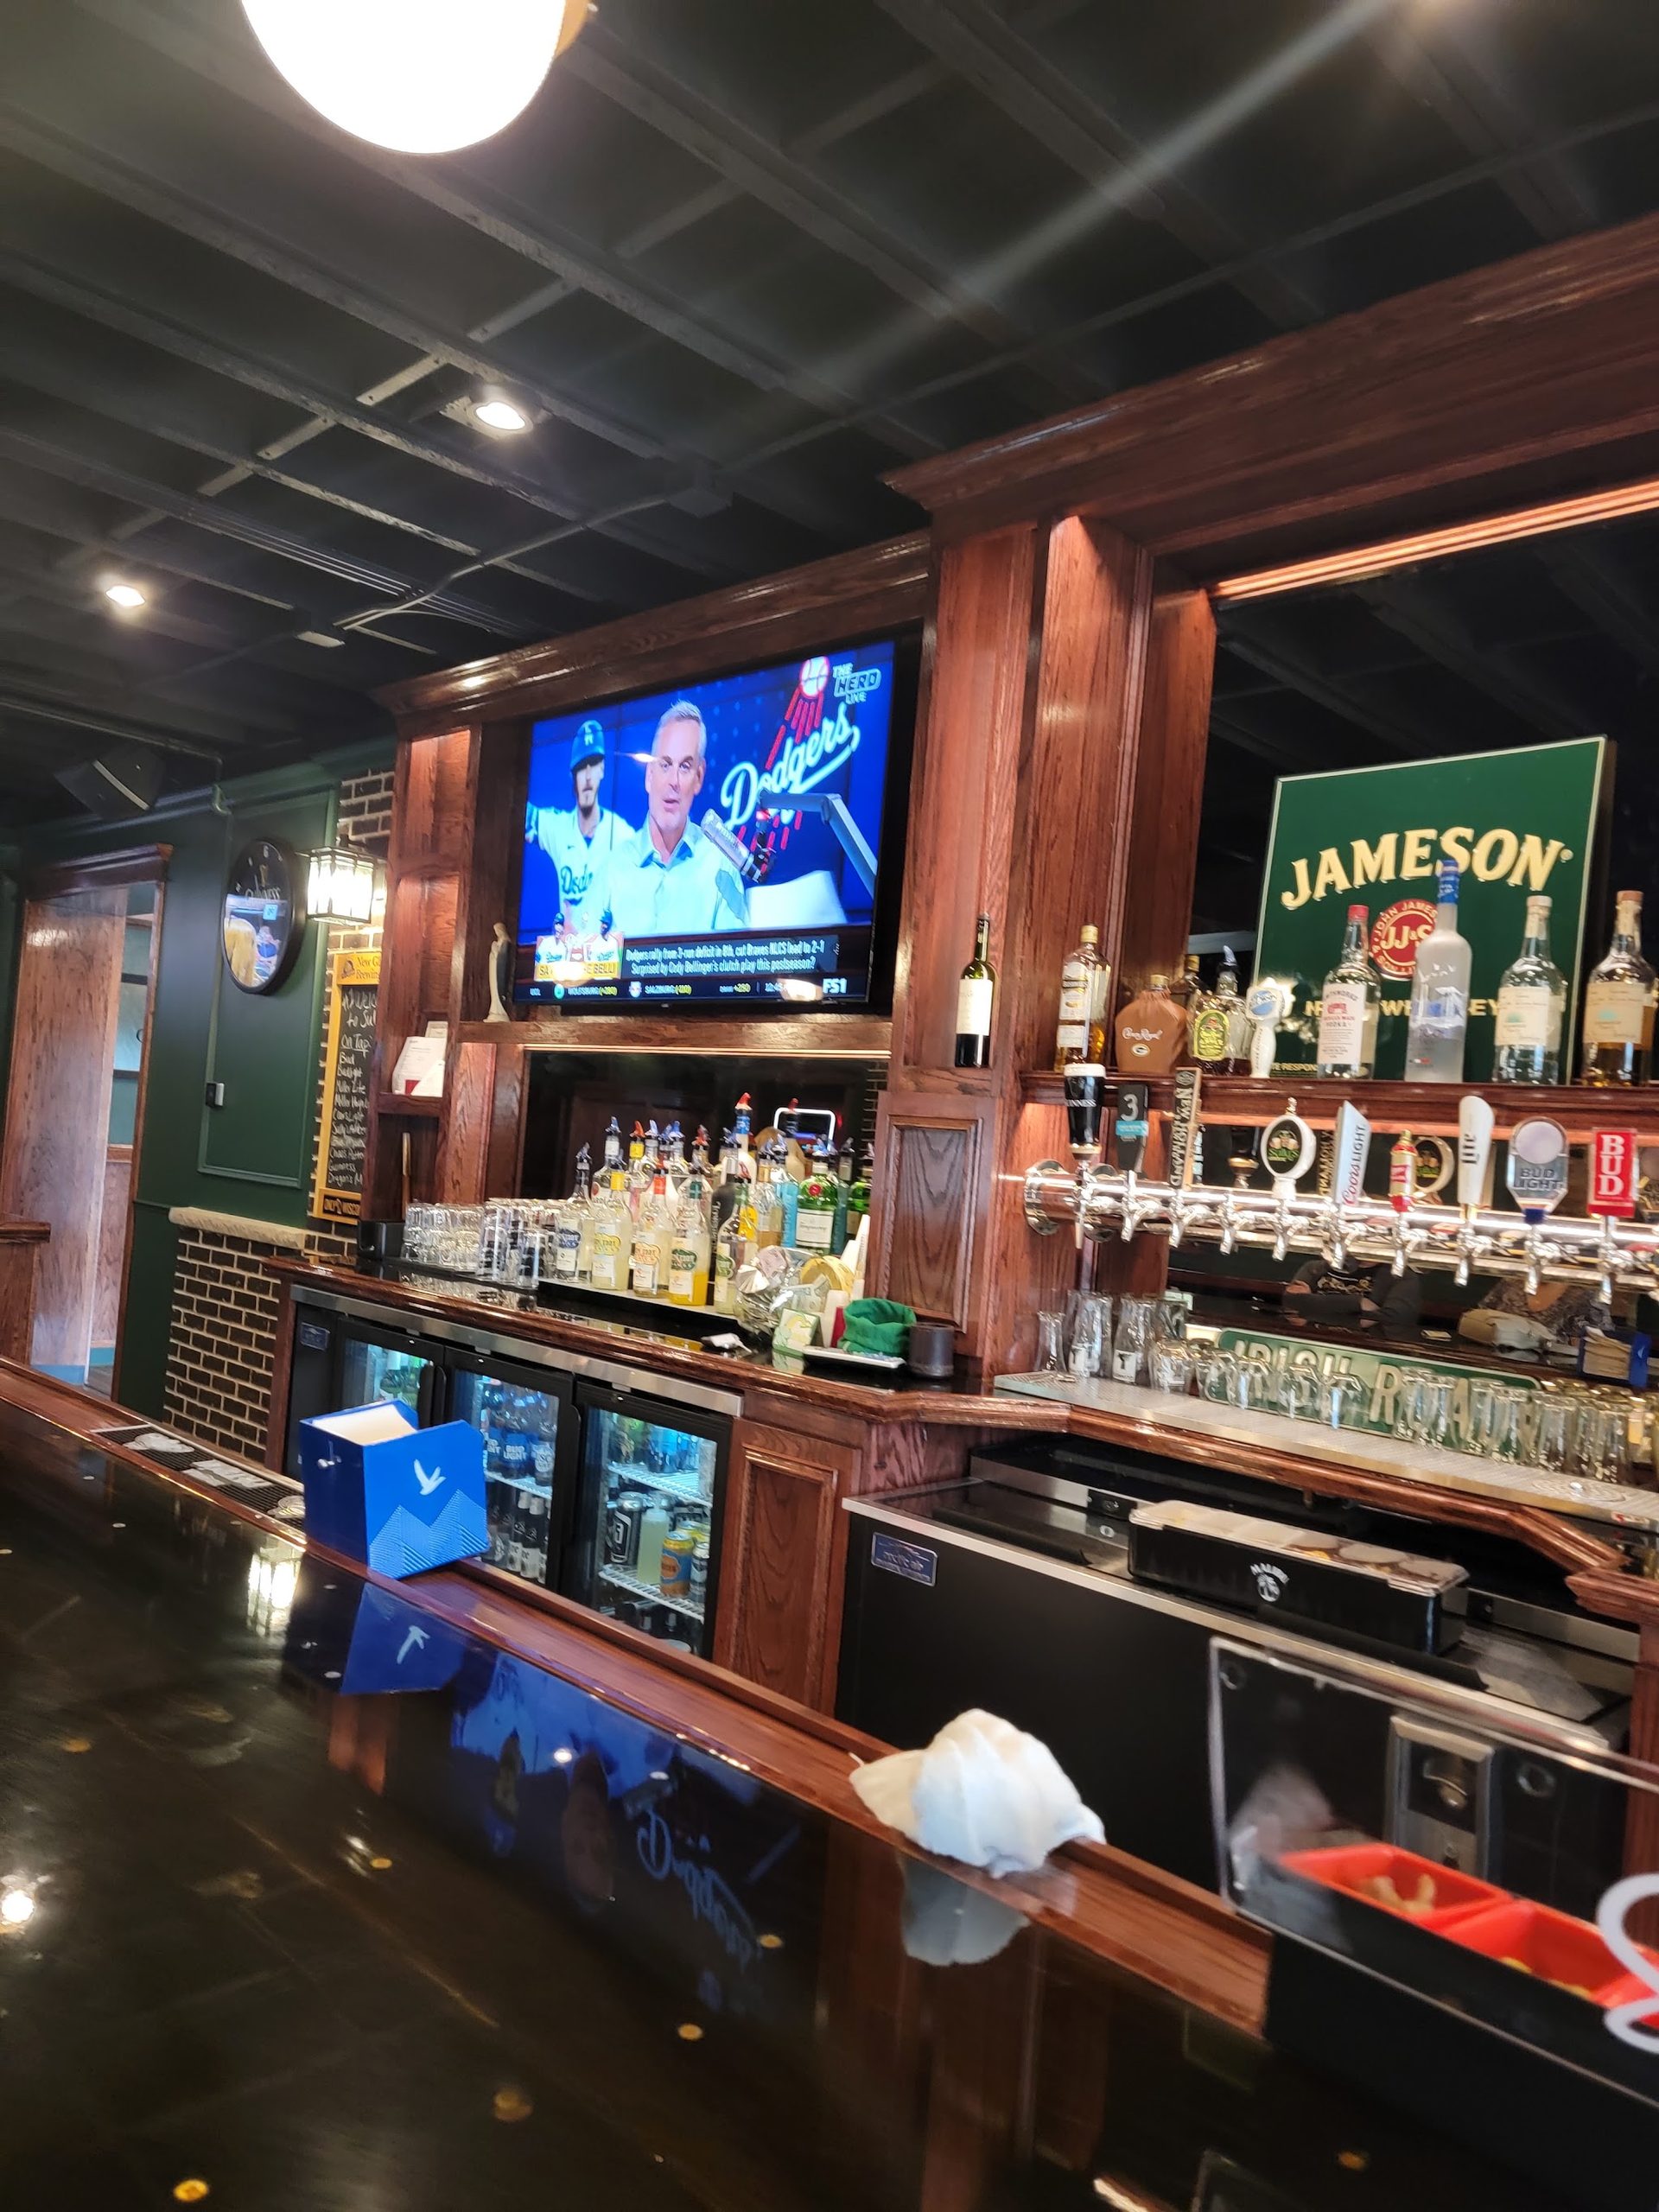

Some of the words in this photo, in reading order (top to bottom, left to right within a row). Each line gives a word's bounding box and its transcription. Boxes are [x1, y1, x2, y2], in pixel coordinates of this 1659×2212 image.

[833, 663, 854, 678] THE
[836, 670, 881, 695] HERD
[721, 702, 861, 831] Dodgers
[1281, 827, 1567, 911] JAMESON
[1374, 907, 1398, 938] JOHN
[1402, 901, 1438, 918] JAMES
[663, 947, 677, 959] from
[677, 946, 695, 959] 3-run
[695, 944, 715, 958] deficit
[715, 944, 722, 957] in
[747, 943, 769, 957] Braves
[769, 941, 787, 955] NLCS
[787, 940, 804, 955] lead
[804, 941, 811, 954] to
[811, 938, 825, 954] 2-1
[719, 958, 741, 972] clutch
[741, 958, 756, 974] play
[756, 957, 771, 970] this
[771, 955, 817, 973] postseason?
[823, 977, 848, 994] FS1
[1121, 1094, 1138, 1122] 3
[1342, 1167, 1360, 1207] Coors
[1355, 1124, 1366, 1165] LIGHT
[1520, 1167, 1555, 1180] BUD
[1599, 1134, 1626, 1196] BUD
[1514, 1179, 1565, 1192] LIGHT
[504, 1452, 527, 1461] LIGHT
[505, 1444, 525, 1452] BUD
